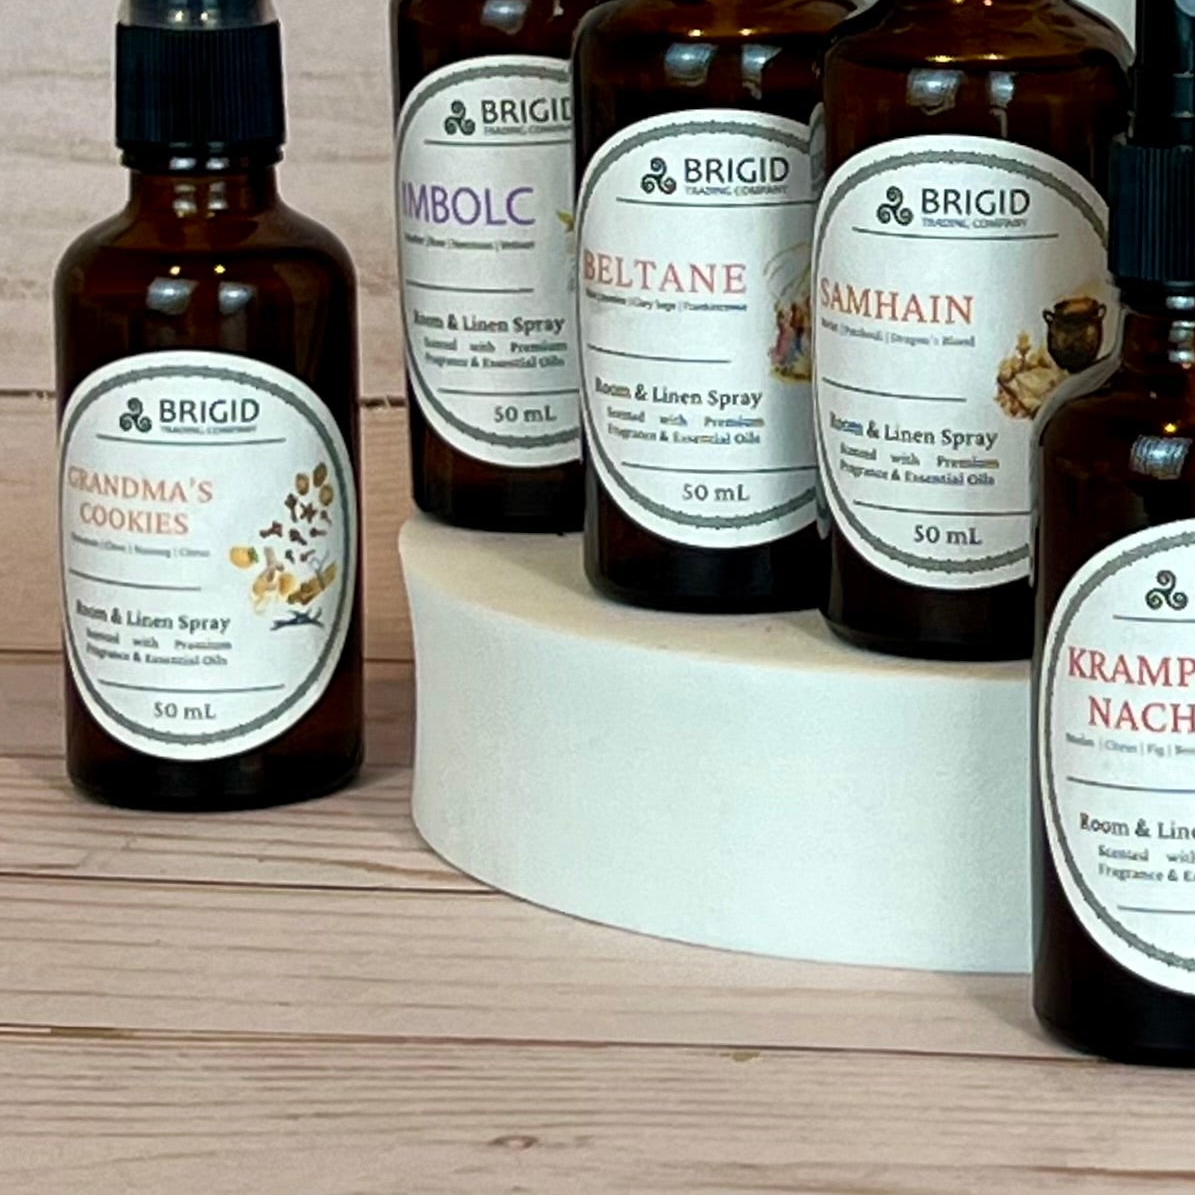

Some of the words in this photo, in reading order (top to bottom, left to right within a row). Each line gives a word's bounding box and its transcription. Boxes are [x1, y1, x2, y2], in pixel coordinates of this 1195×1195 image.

[685, 157, 789, 183] BRIGID
[402, 180, 535, 226] IMBOLC
[921, 189, 1030, 216] BRIGID
[583, 248, 747, 294] BELTANE
[820, 277, 973, 324] SAMHAIN
[448, 314, 457, 331] &
[462, 316, 509, 332] Linen
[513, 317, 565, 335] Spray
[539, 356, 565, 367] Oils
[595, 376, 631, 399] Room
[635, 384, 648, 402] &
[652, 386, 702, 404] Linen
[708, 389, 763, 410] Spray
[160, 399, 260, 424] BRIGID
[494, 406, 518, 423] 50
[523, 406, 556, 422] mL
[659, 412, 687, 427] with
[660, 429, 669, 442] &
[735, 432, 760, 445] Oils
[867, 422, 879, 439] &
[884, 423, 935, 444] Linen
[941, 428, 998, 450] Spray
[67, 465, 214, 503] GRANDMA'S
[967, 472, 996, 485] Oils
[683, 484, 710, 501] 50
[715, 483, 750, 501] mL
[80, 502, 190, 535] COOKIES
[914, 525, 940, 544] 50
[946, 526, 982, 545] mL
[111, 608, 121, 624] &
[126, 609, 173, 629] Linen
[178, 613, 230, 634] Spray
[202, 655, 228, 666] Oils
[154, 702, 178, 719] 50
[183, 702, 216, 720] mL
[1080, 813, 1129, 836] Room
[1135, 819, 1150, 838] &
[1098, 863, 1164, 882] Fragrance
[1168, 868, 1179, 881] &
